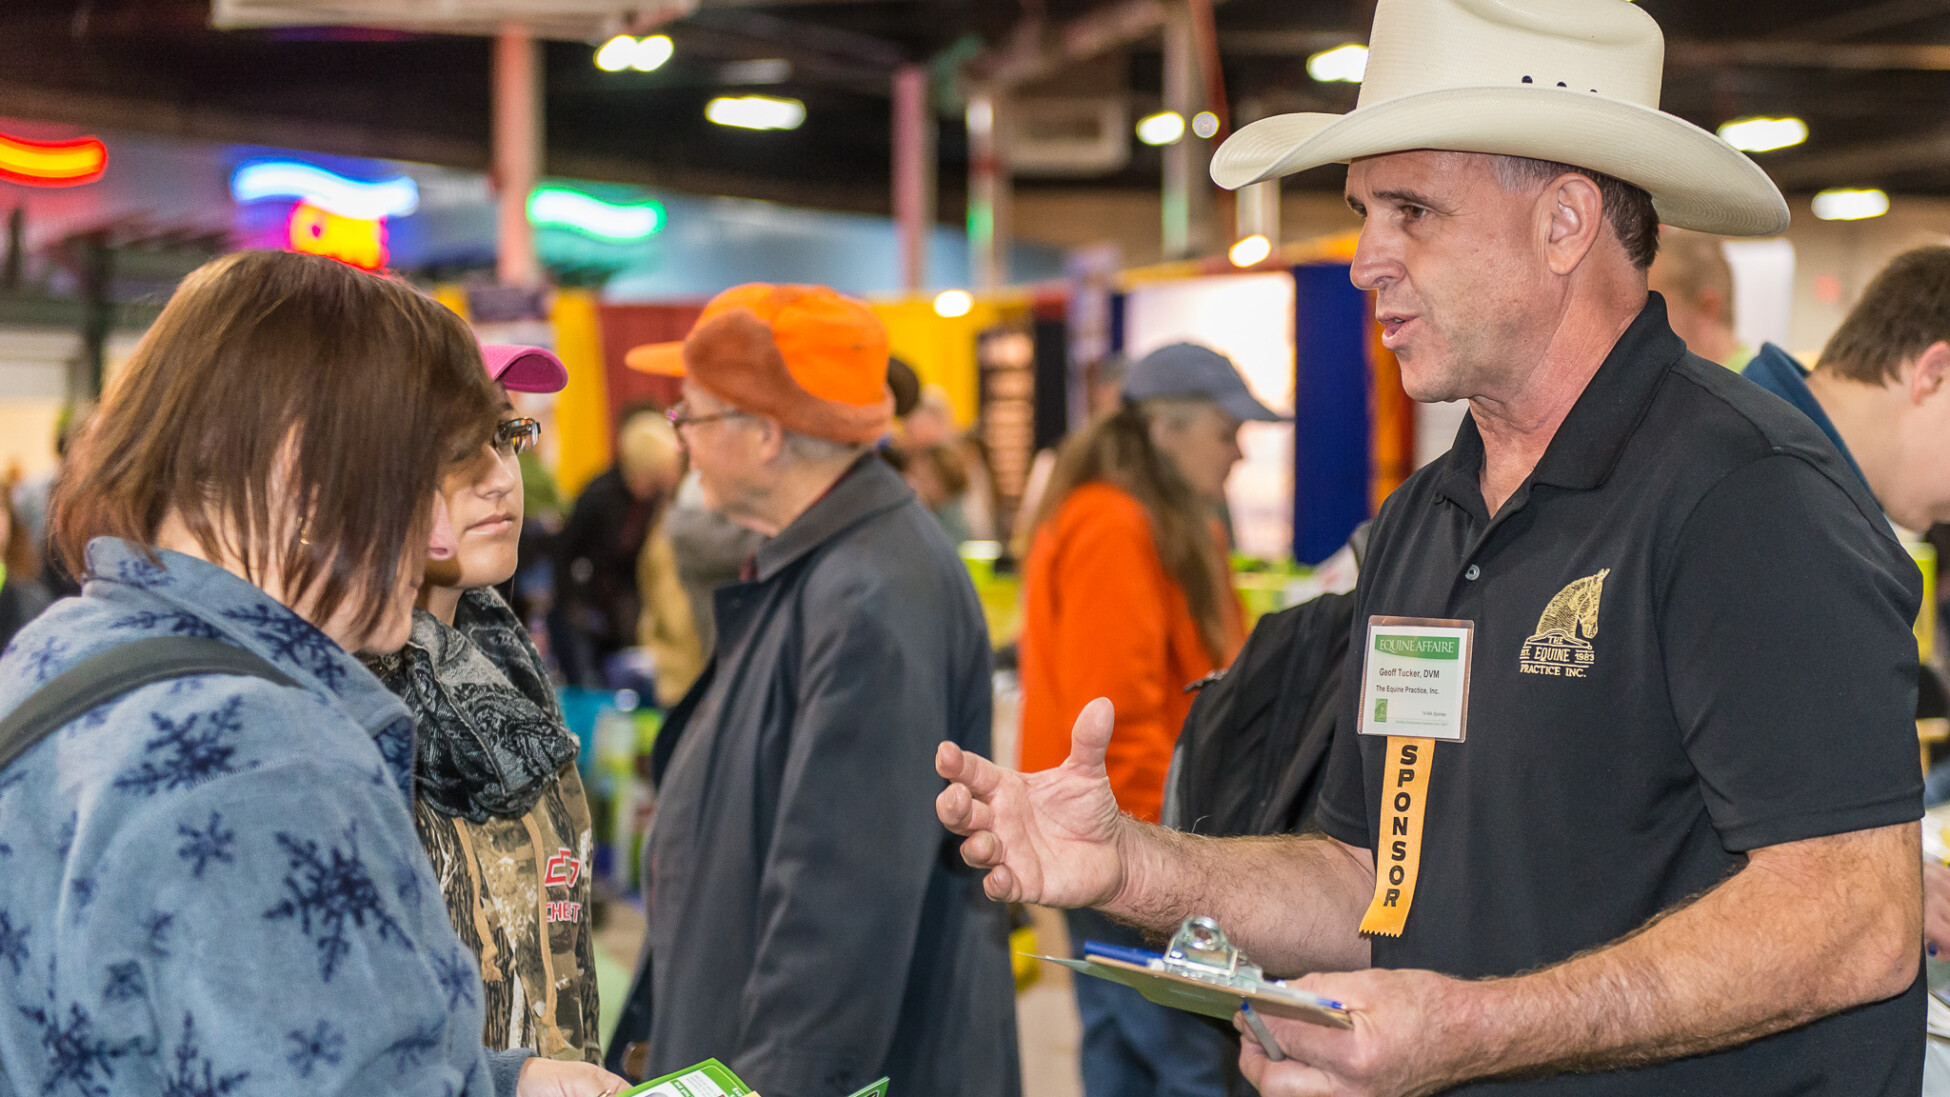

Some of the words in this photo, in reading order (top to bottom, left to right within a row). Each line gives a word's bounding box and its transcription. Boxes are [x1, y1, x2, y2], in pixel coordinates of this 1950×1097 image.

[1547, 635, 1564, 645] THE
[1534, 646, 1571, 662] EQUINE
[1379, 668, 1397, 677] Geoff
[1398, 668, 1421, 679] Tucker,
[1423, 669, 1440, 679] DVM
[1520, 664, 1561, 676] PRACTICE
[1565, 667, 1587, 678] INC.
[1386, 685, 1404, 694] Equine
[1405, 686, 1428, 695] Practice,
[1383, 744, 1419, 908] SPONSOR
